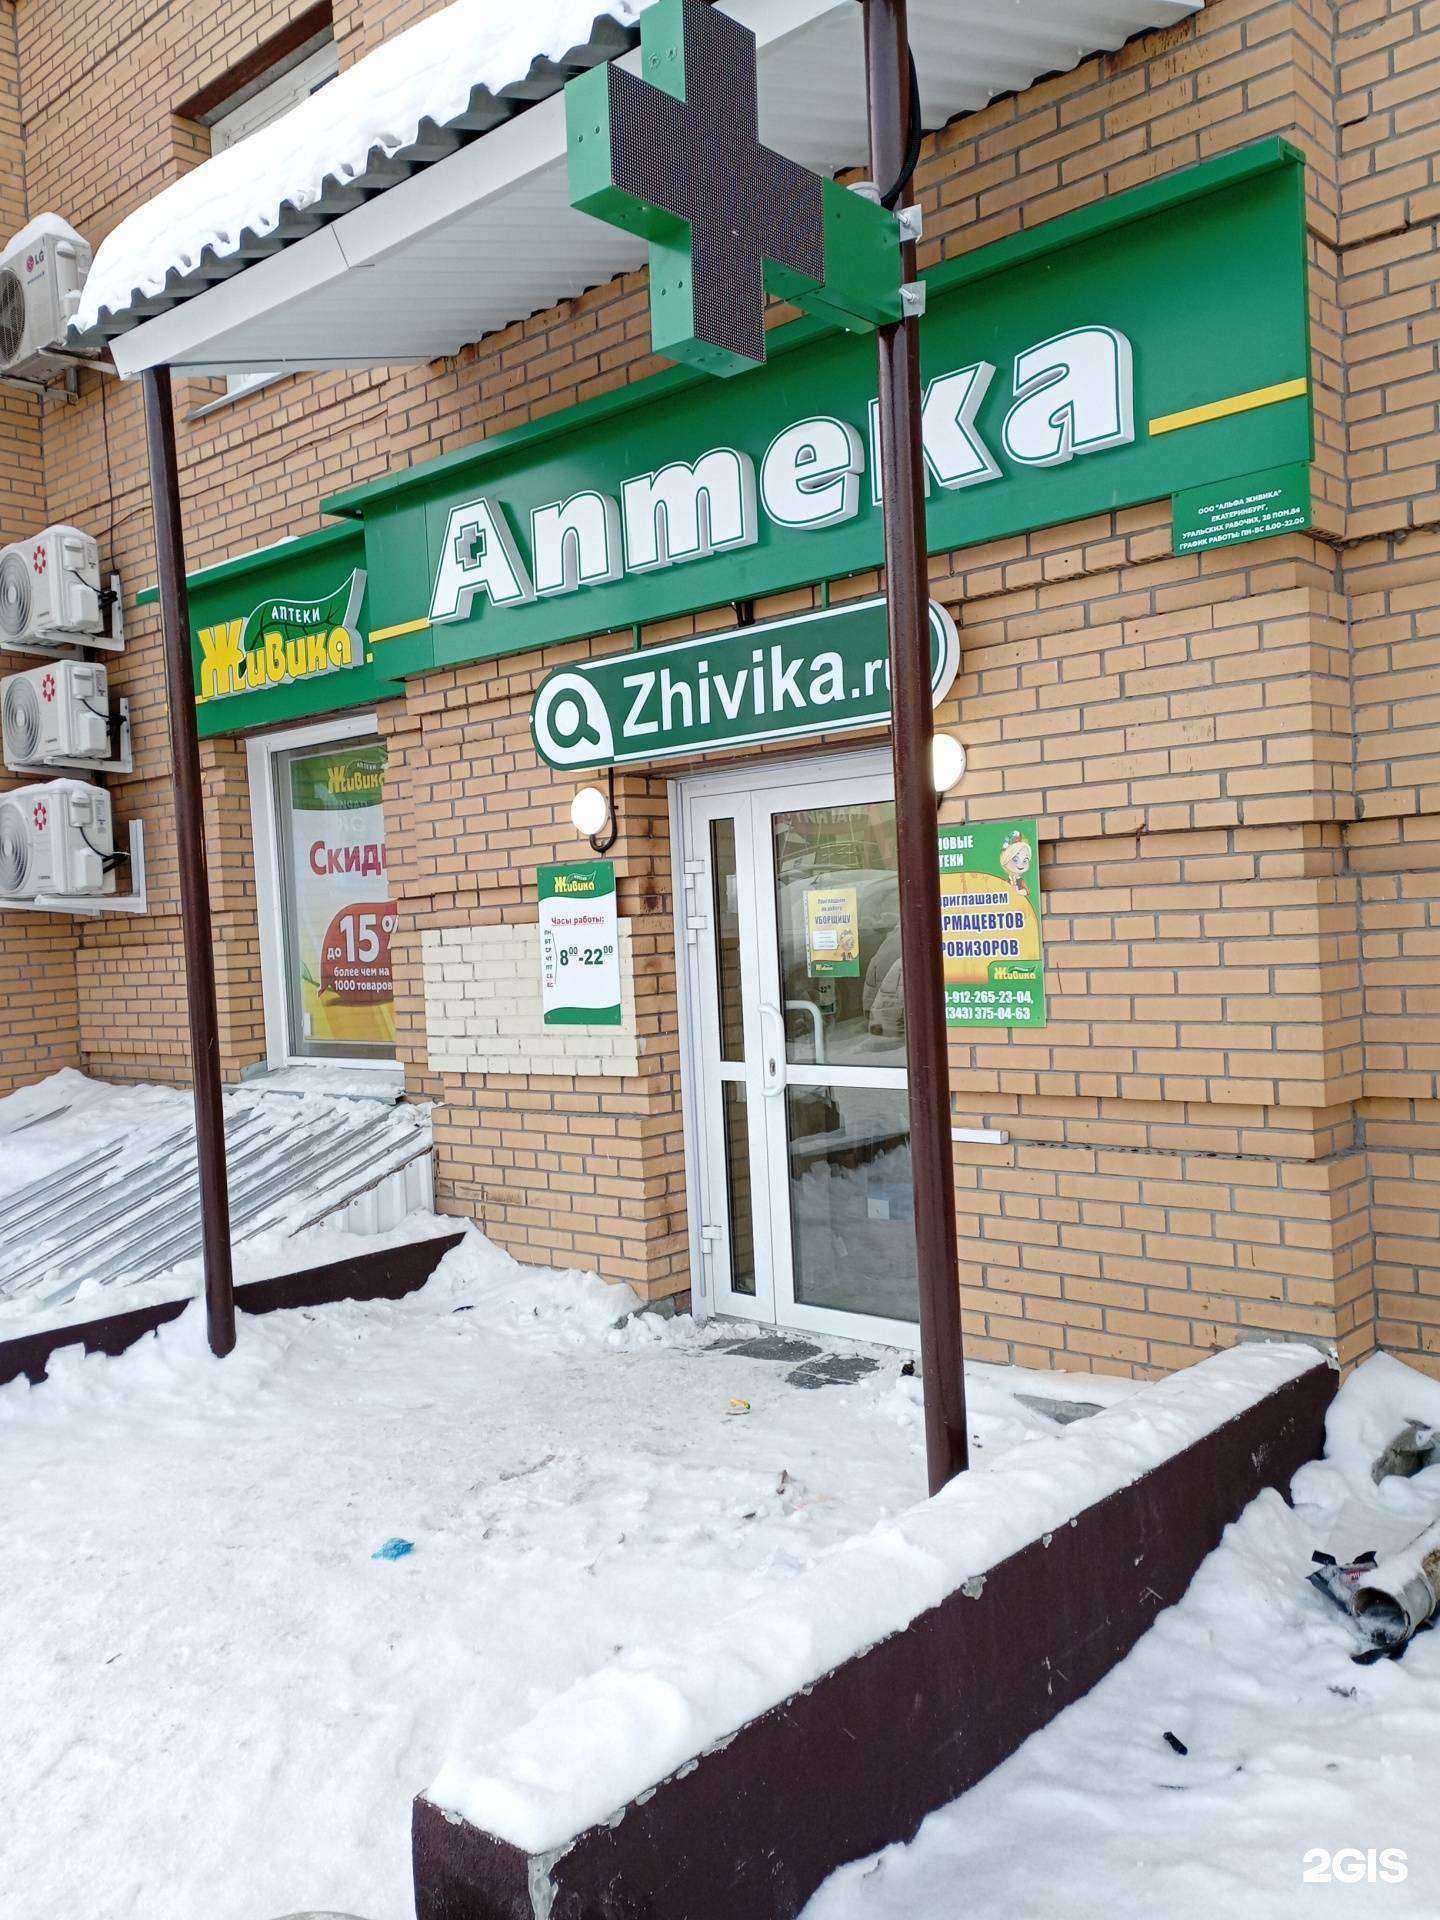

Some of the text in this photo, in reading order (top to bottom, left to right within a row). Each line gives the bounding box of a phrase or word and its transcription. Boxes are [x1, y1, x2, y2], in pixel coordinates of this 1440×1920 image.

[428, 324, 1135, 624] Аптека
[1198, 506, 1214, 515] ООО
[1182, 526, 1224, 540] УРАЛЬСКИХ
[1179, 539, 1208, 550] ГРАФИК
[271, 605, 321, 624] АПТЕКИ
[198, 617, 356, 700] Живика
[554, 876, 595, 893] Живика
[940, 893, 1008, 907] риглашаем
[551, 915, 605, 926] Часы работы:
[940, 912, 1024, 931] РМАЦЕВТОВ
[327, 947, 342, 960] до
[334, 966, 390, 977] более чем на
[334, 980, 393, 993] 1000 товаров
[974, 1007, 1030, 1020] 375-04-63
